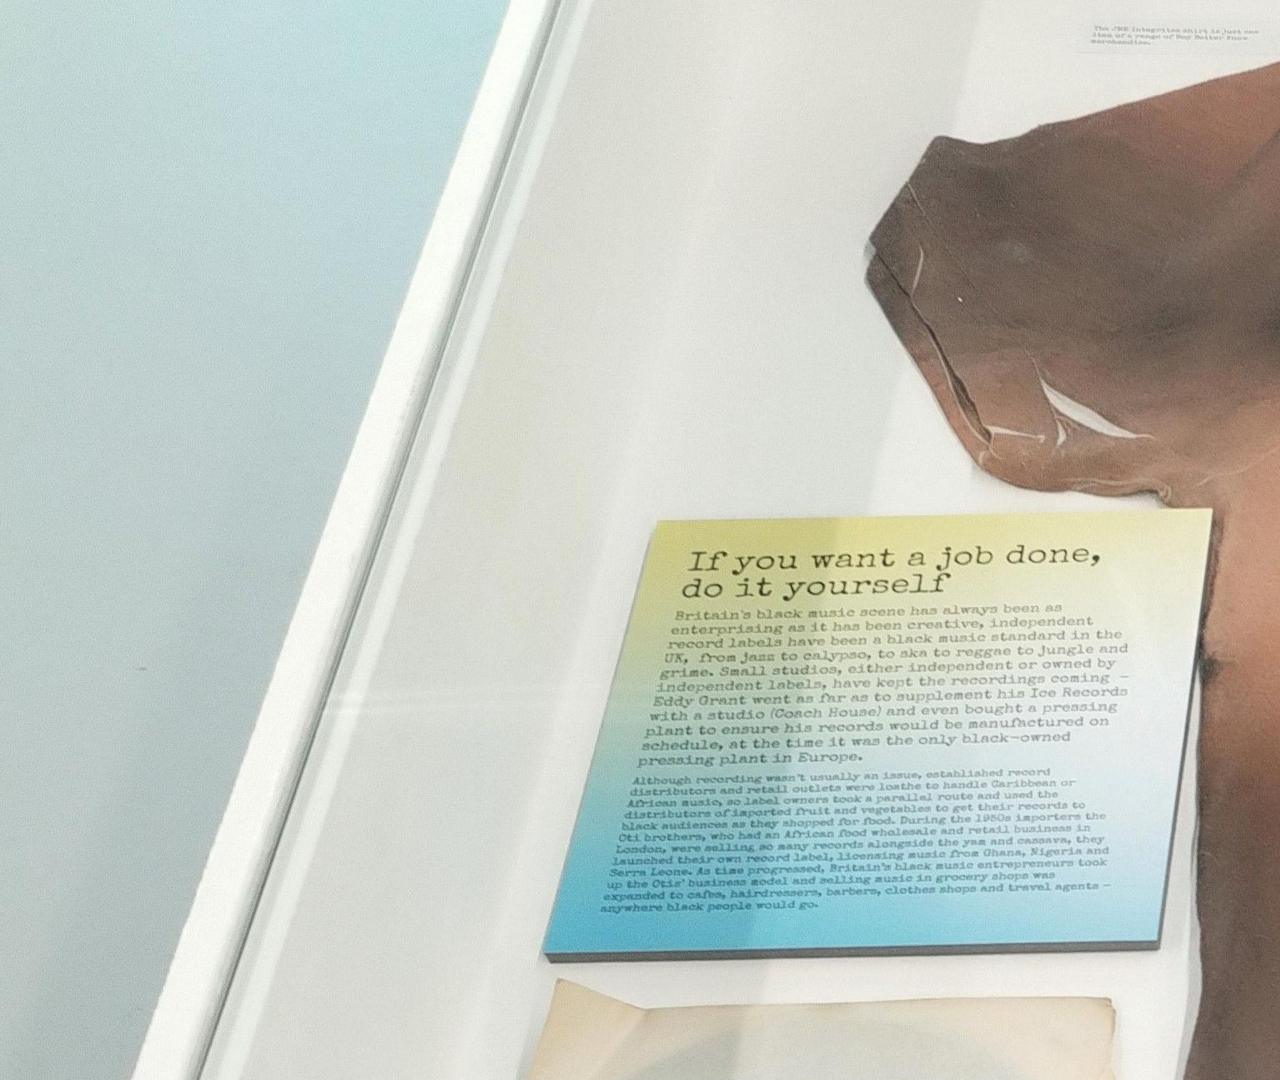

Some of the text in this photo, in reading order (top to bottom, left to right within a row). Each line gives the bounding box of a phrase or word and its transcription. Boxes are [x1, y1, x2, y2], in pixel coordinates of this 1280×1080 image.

[688, 544, 1101, 576] If you want a job done,
[681, 569, 952, 602] do it yourself
[674, 603, 1063, 621] Britain's black music scene has always been as
[670, 615, 1094, 637] enterprising as it has been creative, independent
[656, 680, 763, 694] independent
[768, 679, 827, 691] labels,
[832, 678, 871, 689] have
[876, 677, 913, 690] kept
[918, 676, 946, 687] the
[950, 674, 1046, 687] recordings
[1050, 673, 1111, 685] coming
[636, 751, 864, 769] pressing plant in Europe.
